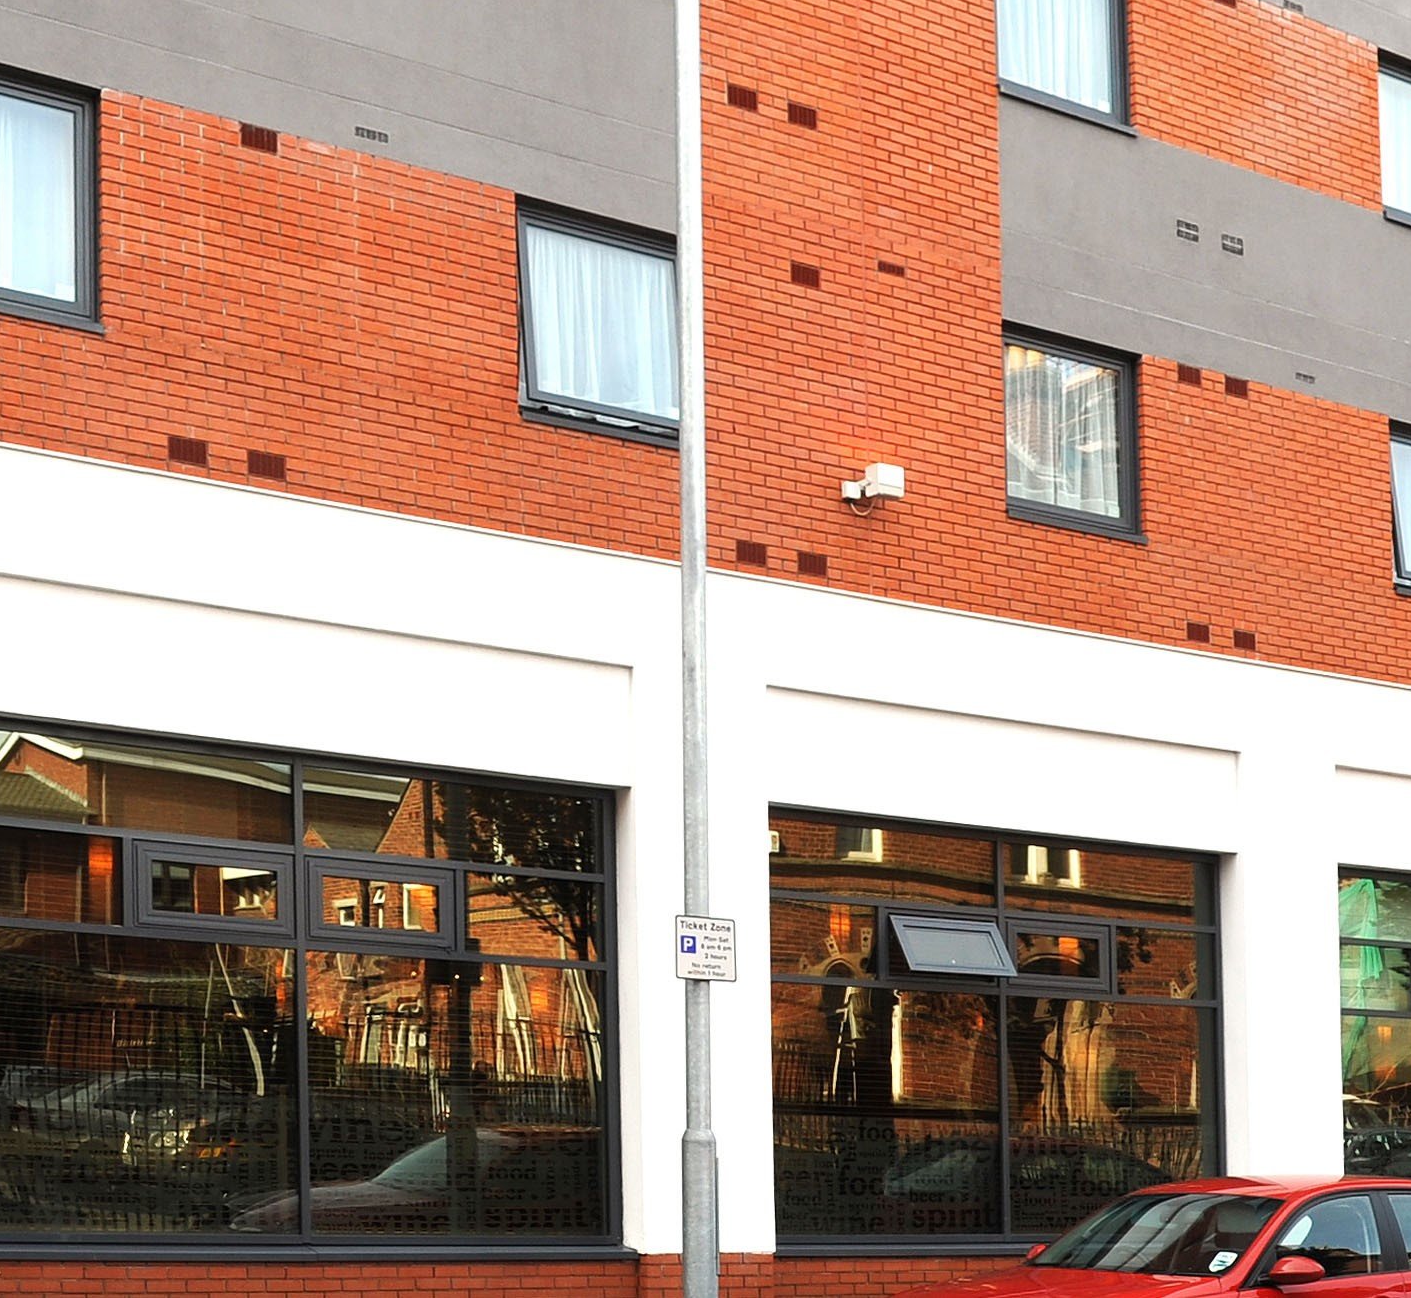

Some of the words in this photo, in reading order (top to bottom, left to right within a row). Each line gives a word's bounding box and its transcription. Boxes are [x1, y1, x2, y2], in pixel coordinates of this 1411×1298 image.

[680, 920, 707, 931] Ticket
[710, 922, 731, 933] Zone
[909, 1187, 946, 1202] beer
